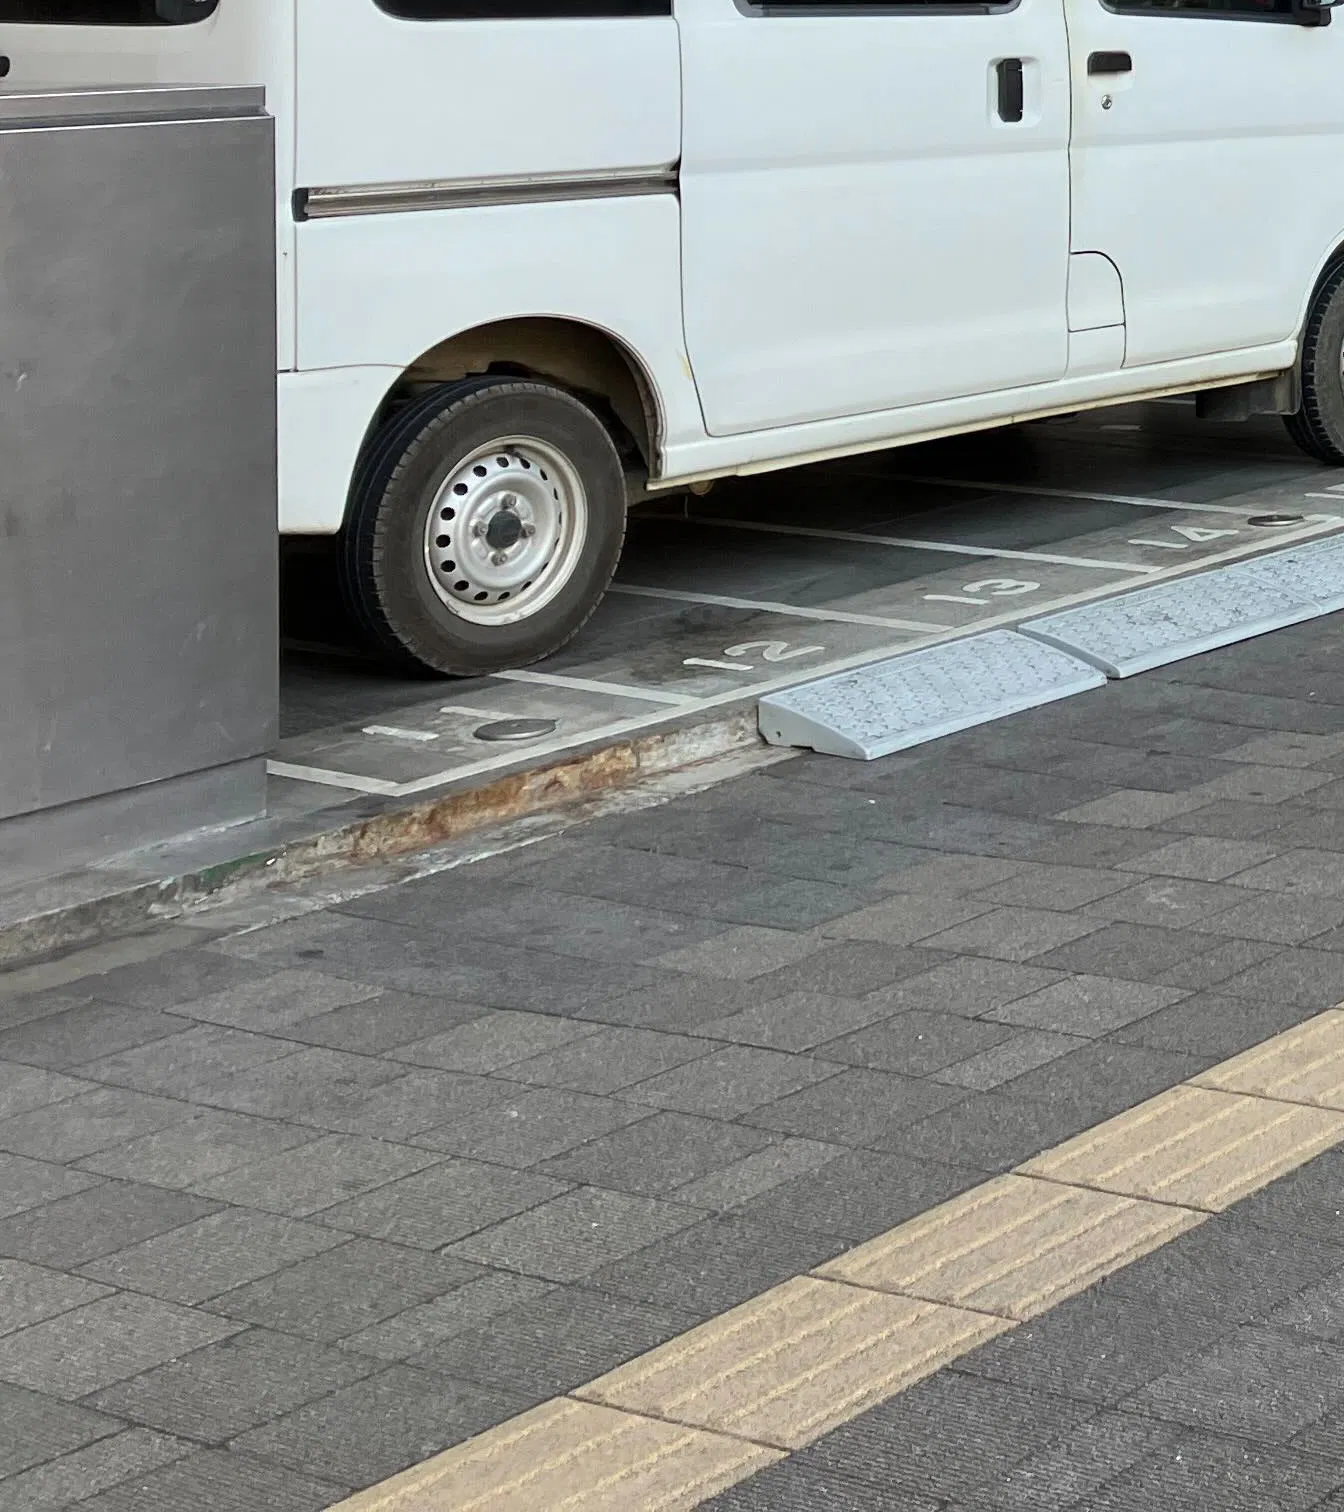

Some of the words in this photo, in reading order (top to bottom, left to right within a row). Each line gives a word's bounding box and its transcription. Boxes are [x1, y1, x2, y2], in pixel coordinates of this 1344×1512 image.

[1127, 524, 1240, 550] 14
[922, 578, 1042, 607] 13
[682, 639, 826, 672] 12
